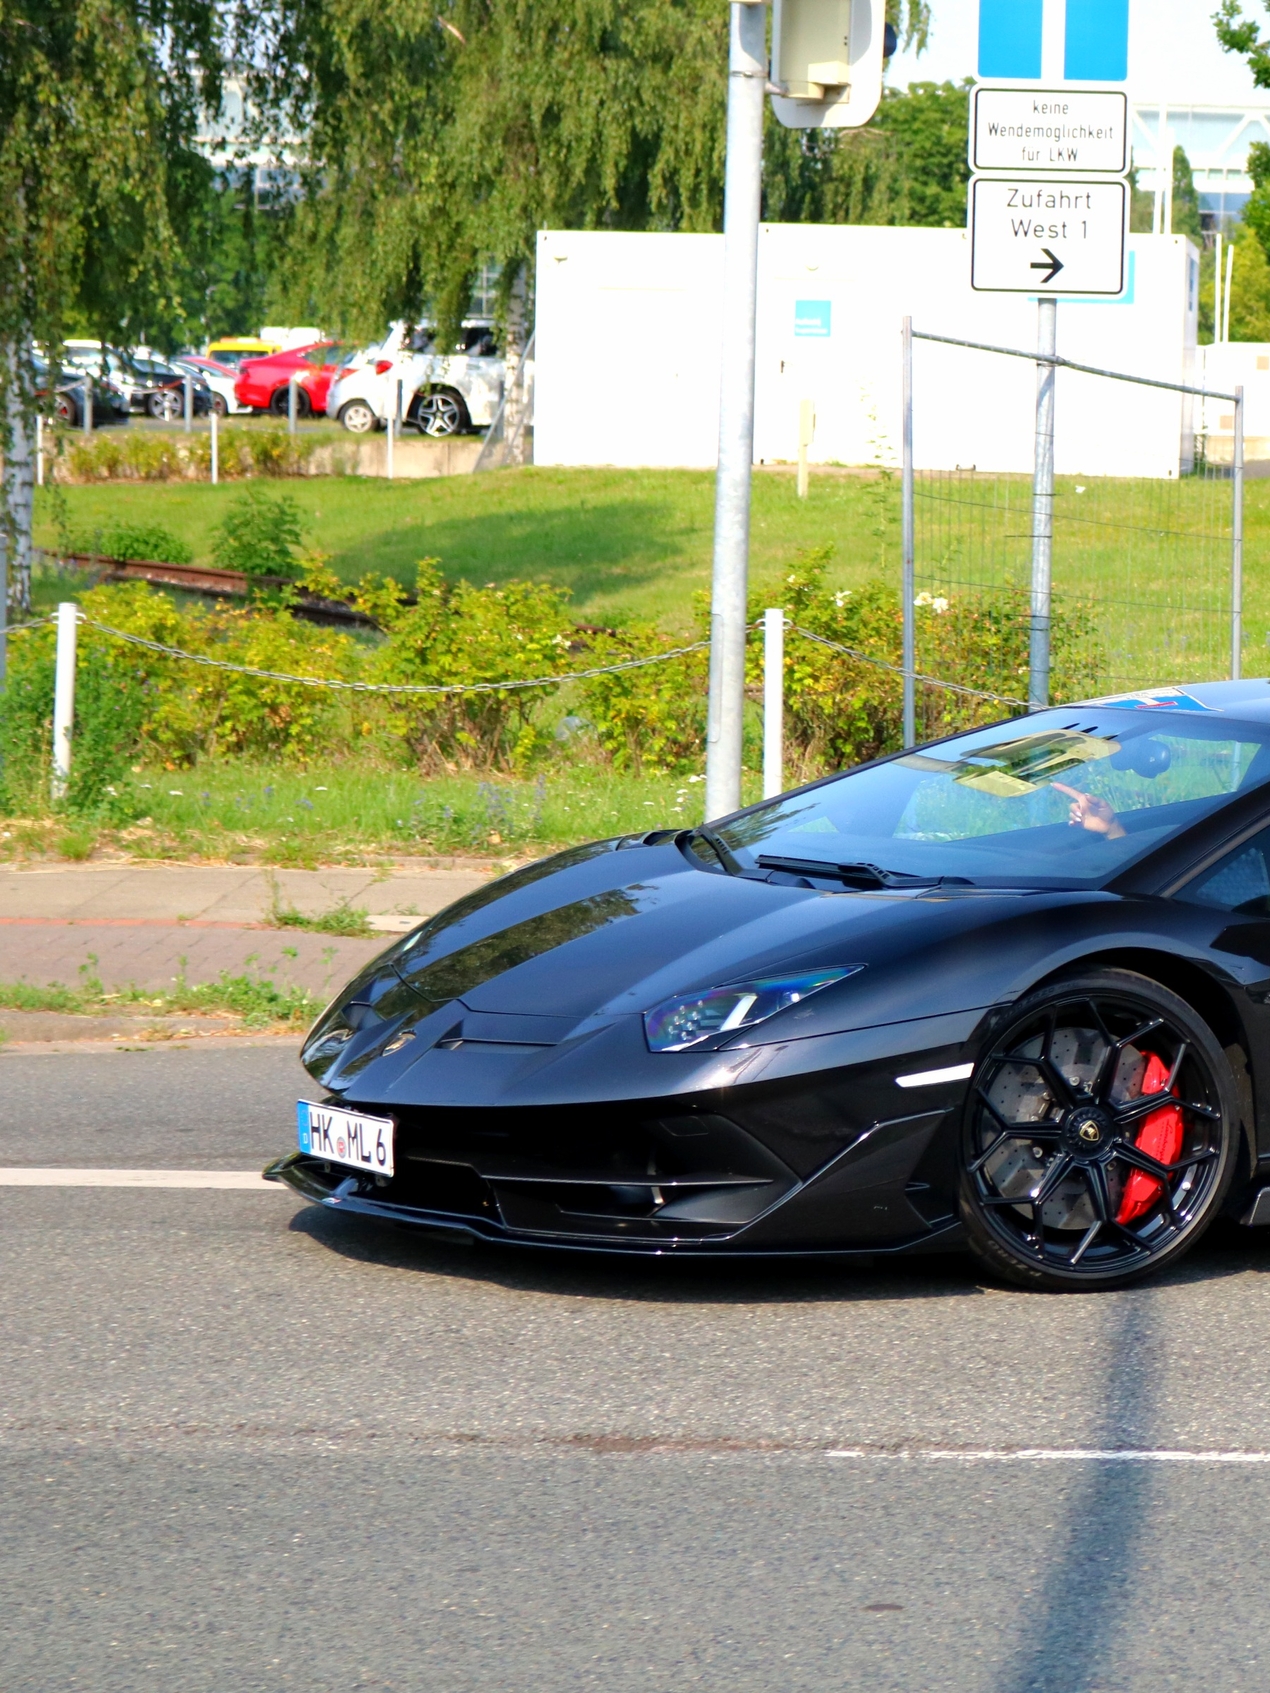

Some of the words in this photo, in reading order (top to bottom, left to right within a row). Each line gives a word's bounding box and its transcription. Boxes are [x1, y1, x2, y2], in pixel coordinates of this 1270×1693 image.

[1032, 100, 1069, 115] keine
[987, 121, 1114, 143] Wendemöglichkeit
[1021, 146, 1041, 162] für
[1049, 147, 1078, 162] LKW
[1006, 188, 1092, 210] Zufahrt
[1010, 218, 1068, 239] West
[1081, 220, 1088, 240] 1
[309, 1111, 335, 1154] HK
[346, 1120, 372, 1164] ML
[375, 1128, 387, 1167] 6
